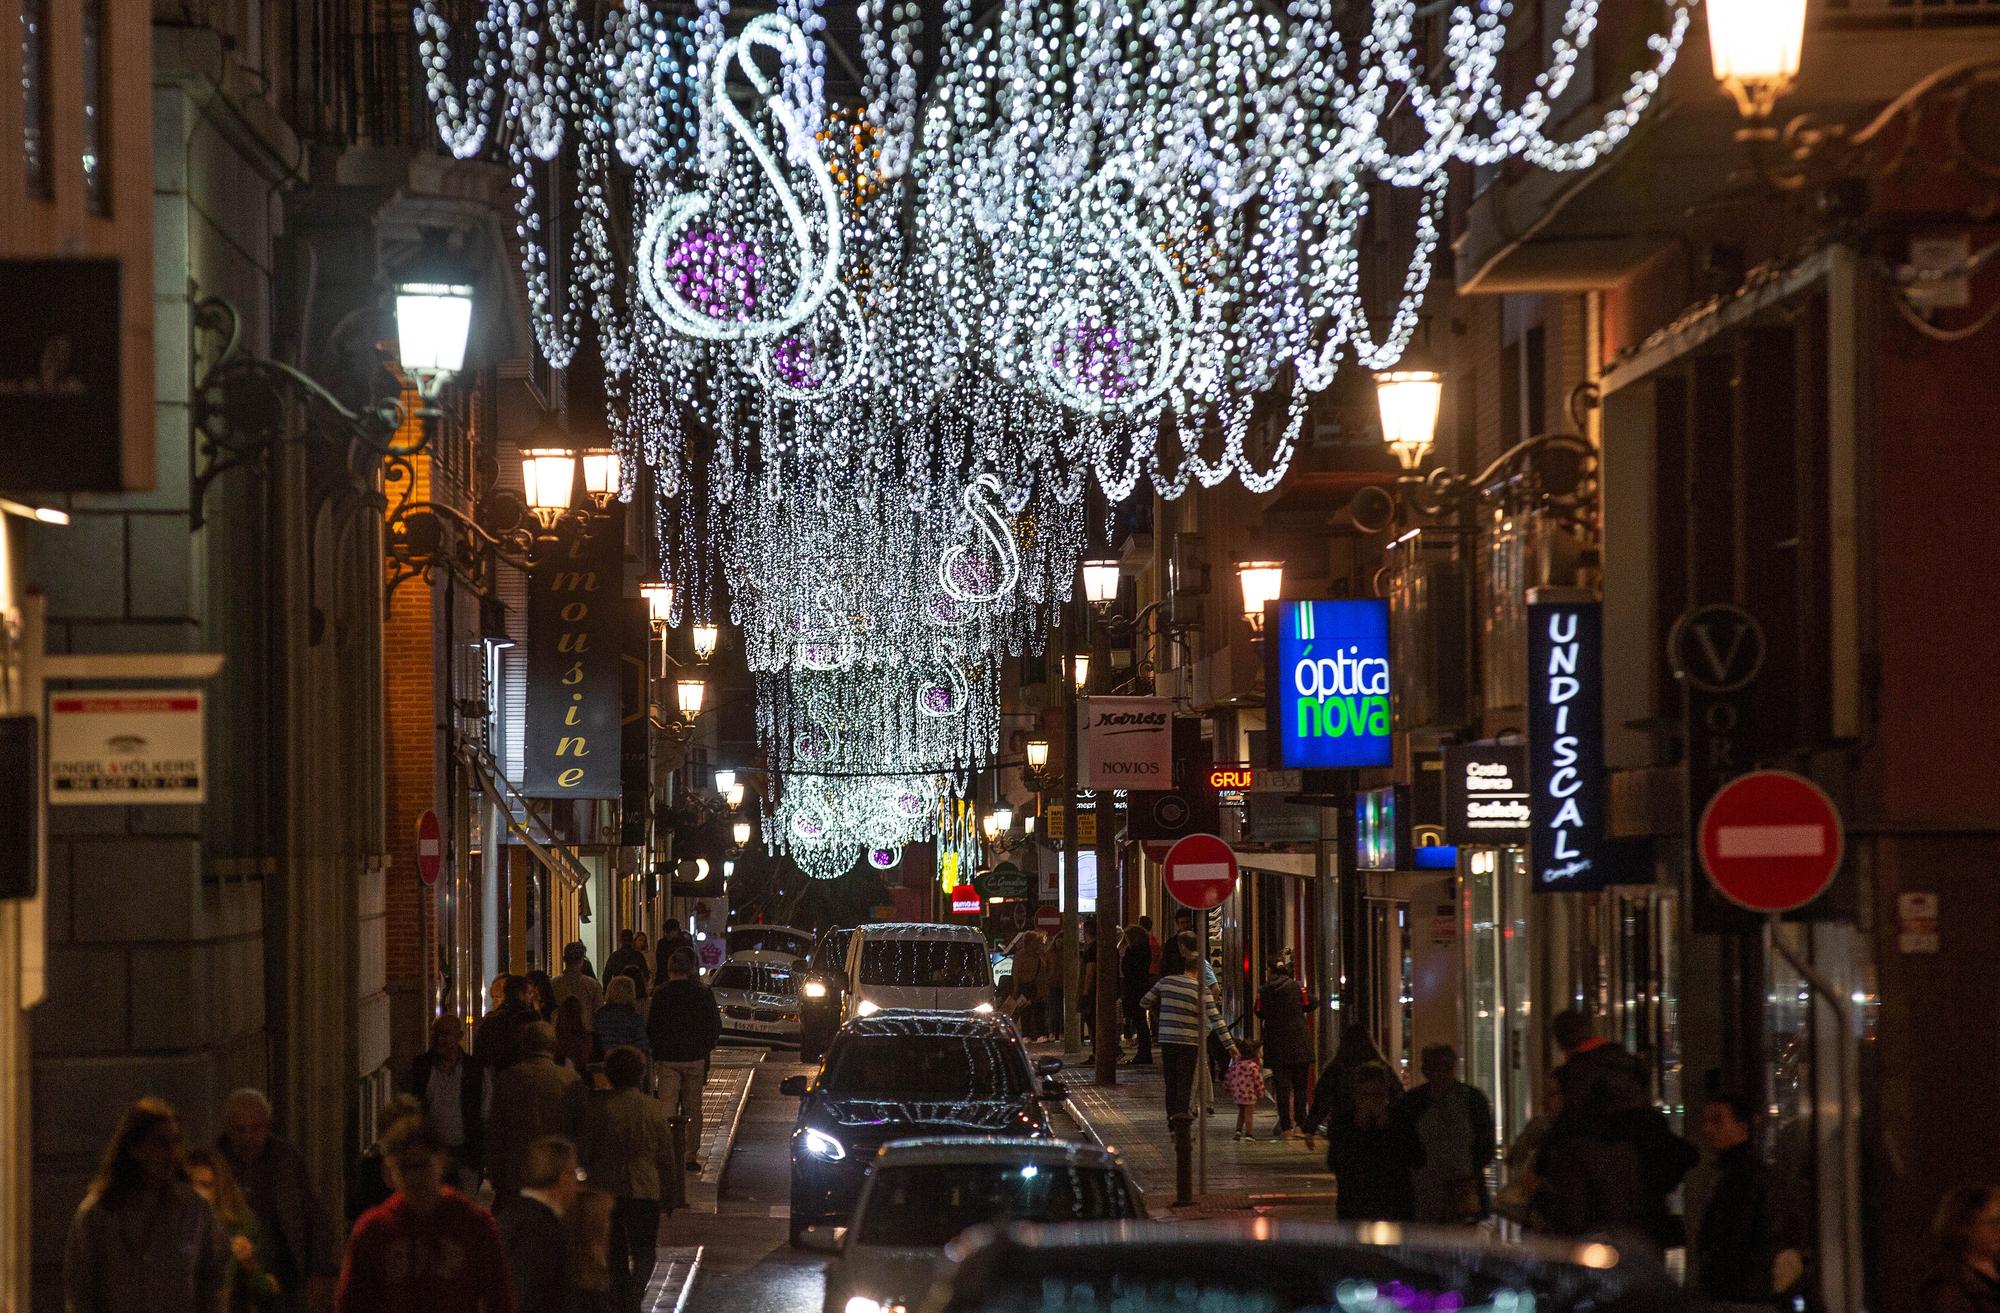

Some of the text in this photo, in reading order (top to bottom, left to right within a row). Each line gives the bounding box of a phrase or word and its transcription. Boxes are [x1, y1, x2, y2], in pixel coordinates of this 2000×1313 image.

[1294, 644, 1390, 704] óptica
[1297, 696, 1391, 737] nova
[1548, 613, 1584, 860] UNDISCAL
[1102, 762, 1160, 775] NOVIOS
